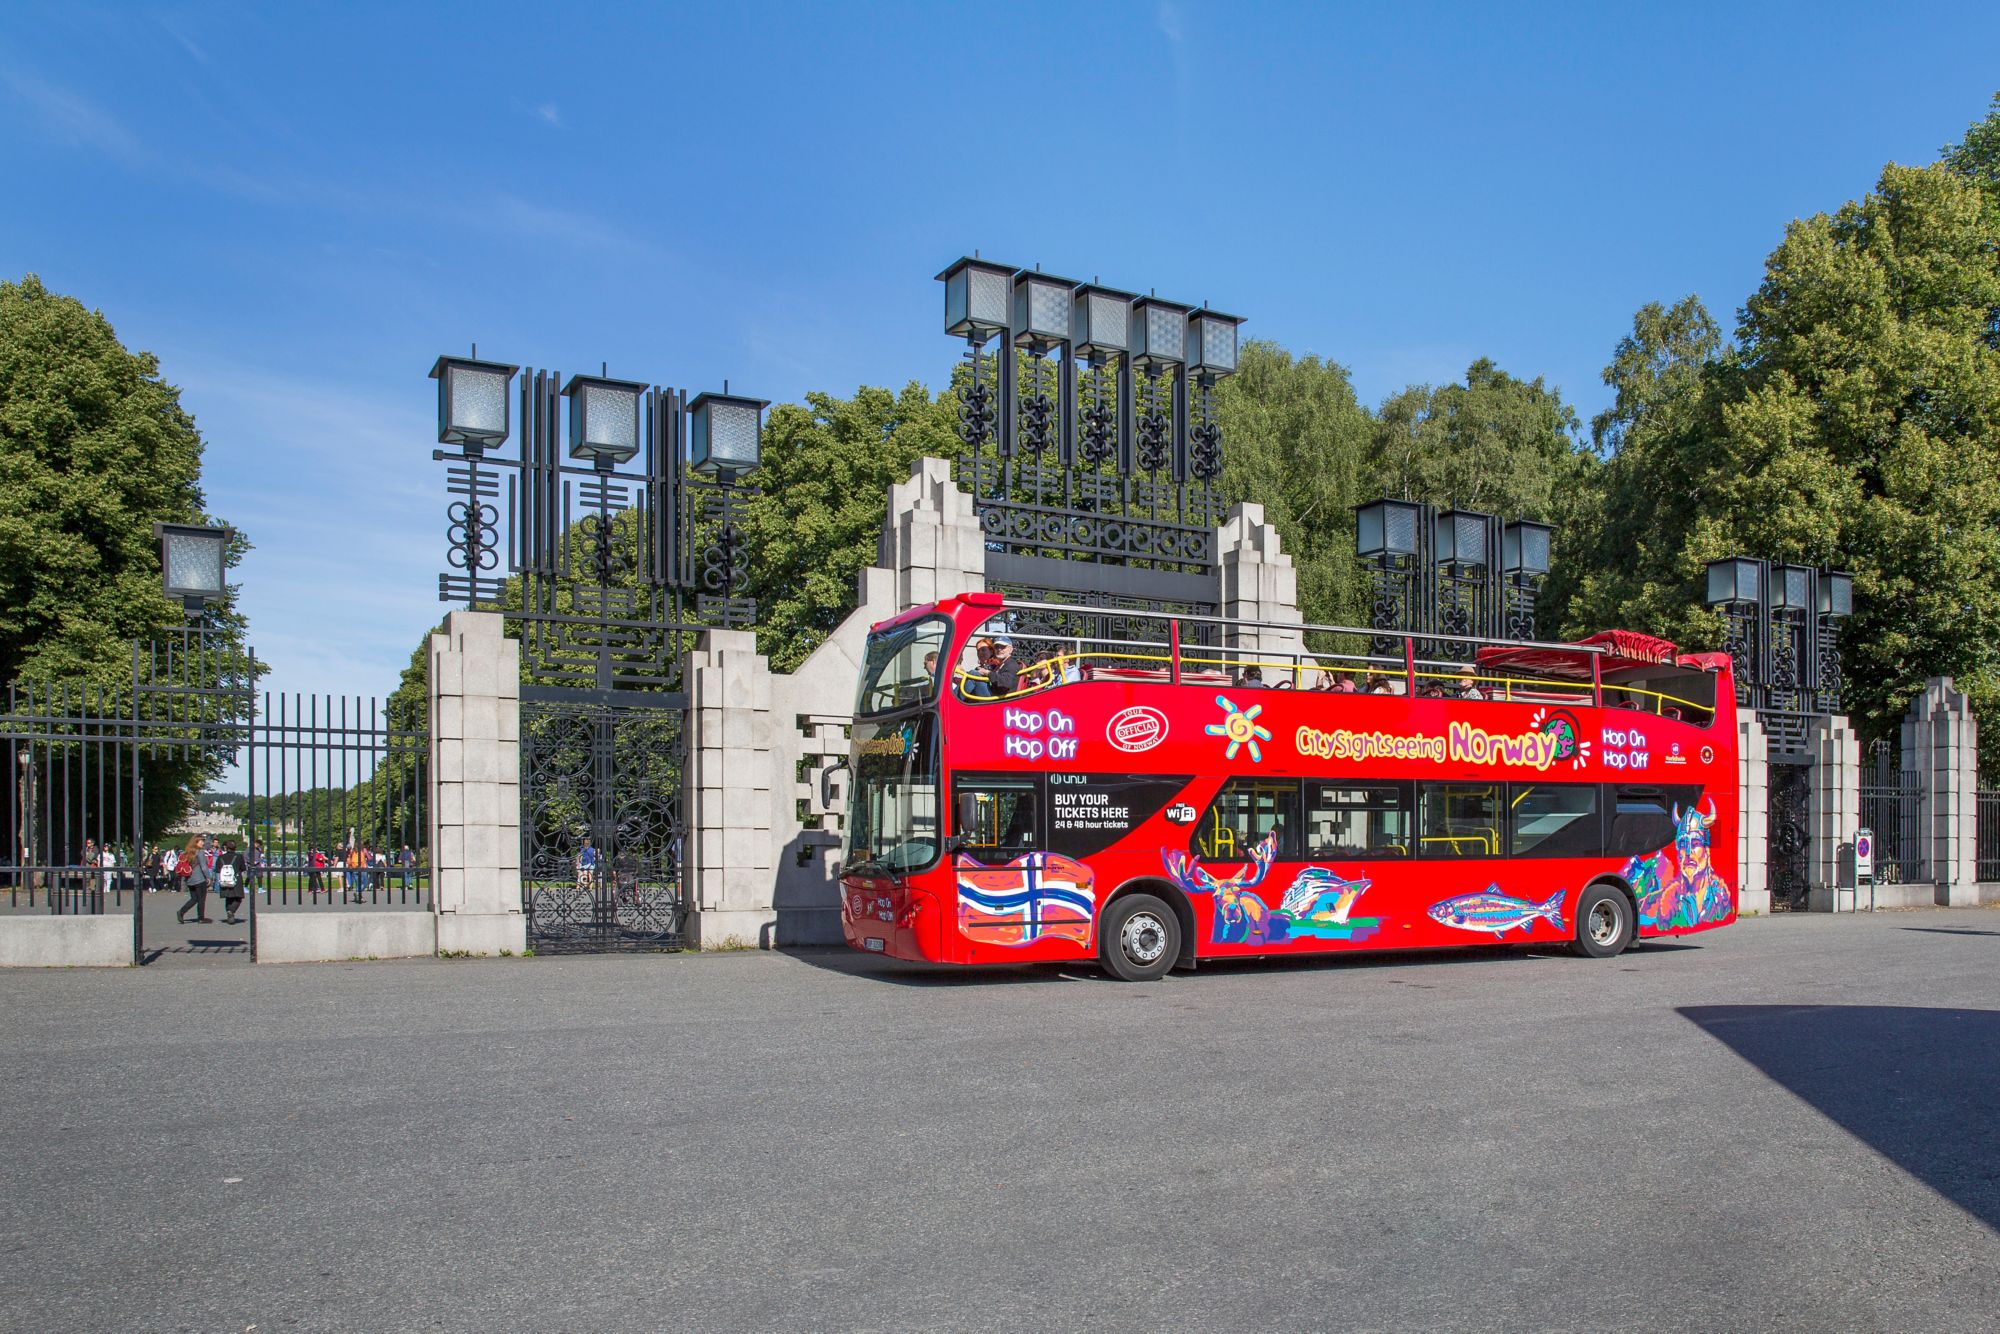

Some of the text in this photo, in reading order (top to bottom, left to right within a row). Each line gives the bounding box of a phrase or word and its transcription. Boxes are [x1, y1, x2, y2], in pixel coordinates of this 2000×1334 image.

[1004, 707, 1074, 733] Hop On
[1123, 708, 1143, 718] TOUR
[1118, 721, 1158, 738] OFFICIAL
[1122, 736, 1160, 751] OF NORWAY
[1449, 721, 1556, 771] Norway
[1602, 729, 1646, 748] Hop On
[1005, 735, 1079, 760] Hop Off
[1603, 750, 1649, 769] Hop Off
[1055, 794, 1109, 805] BUY YOUR
[1055, 807, 1129, 818] TICKETS HERE
[1055, 820, 1129, 829] 24 & 48 hour tickets
